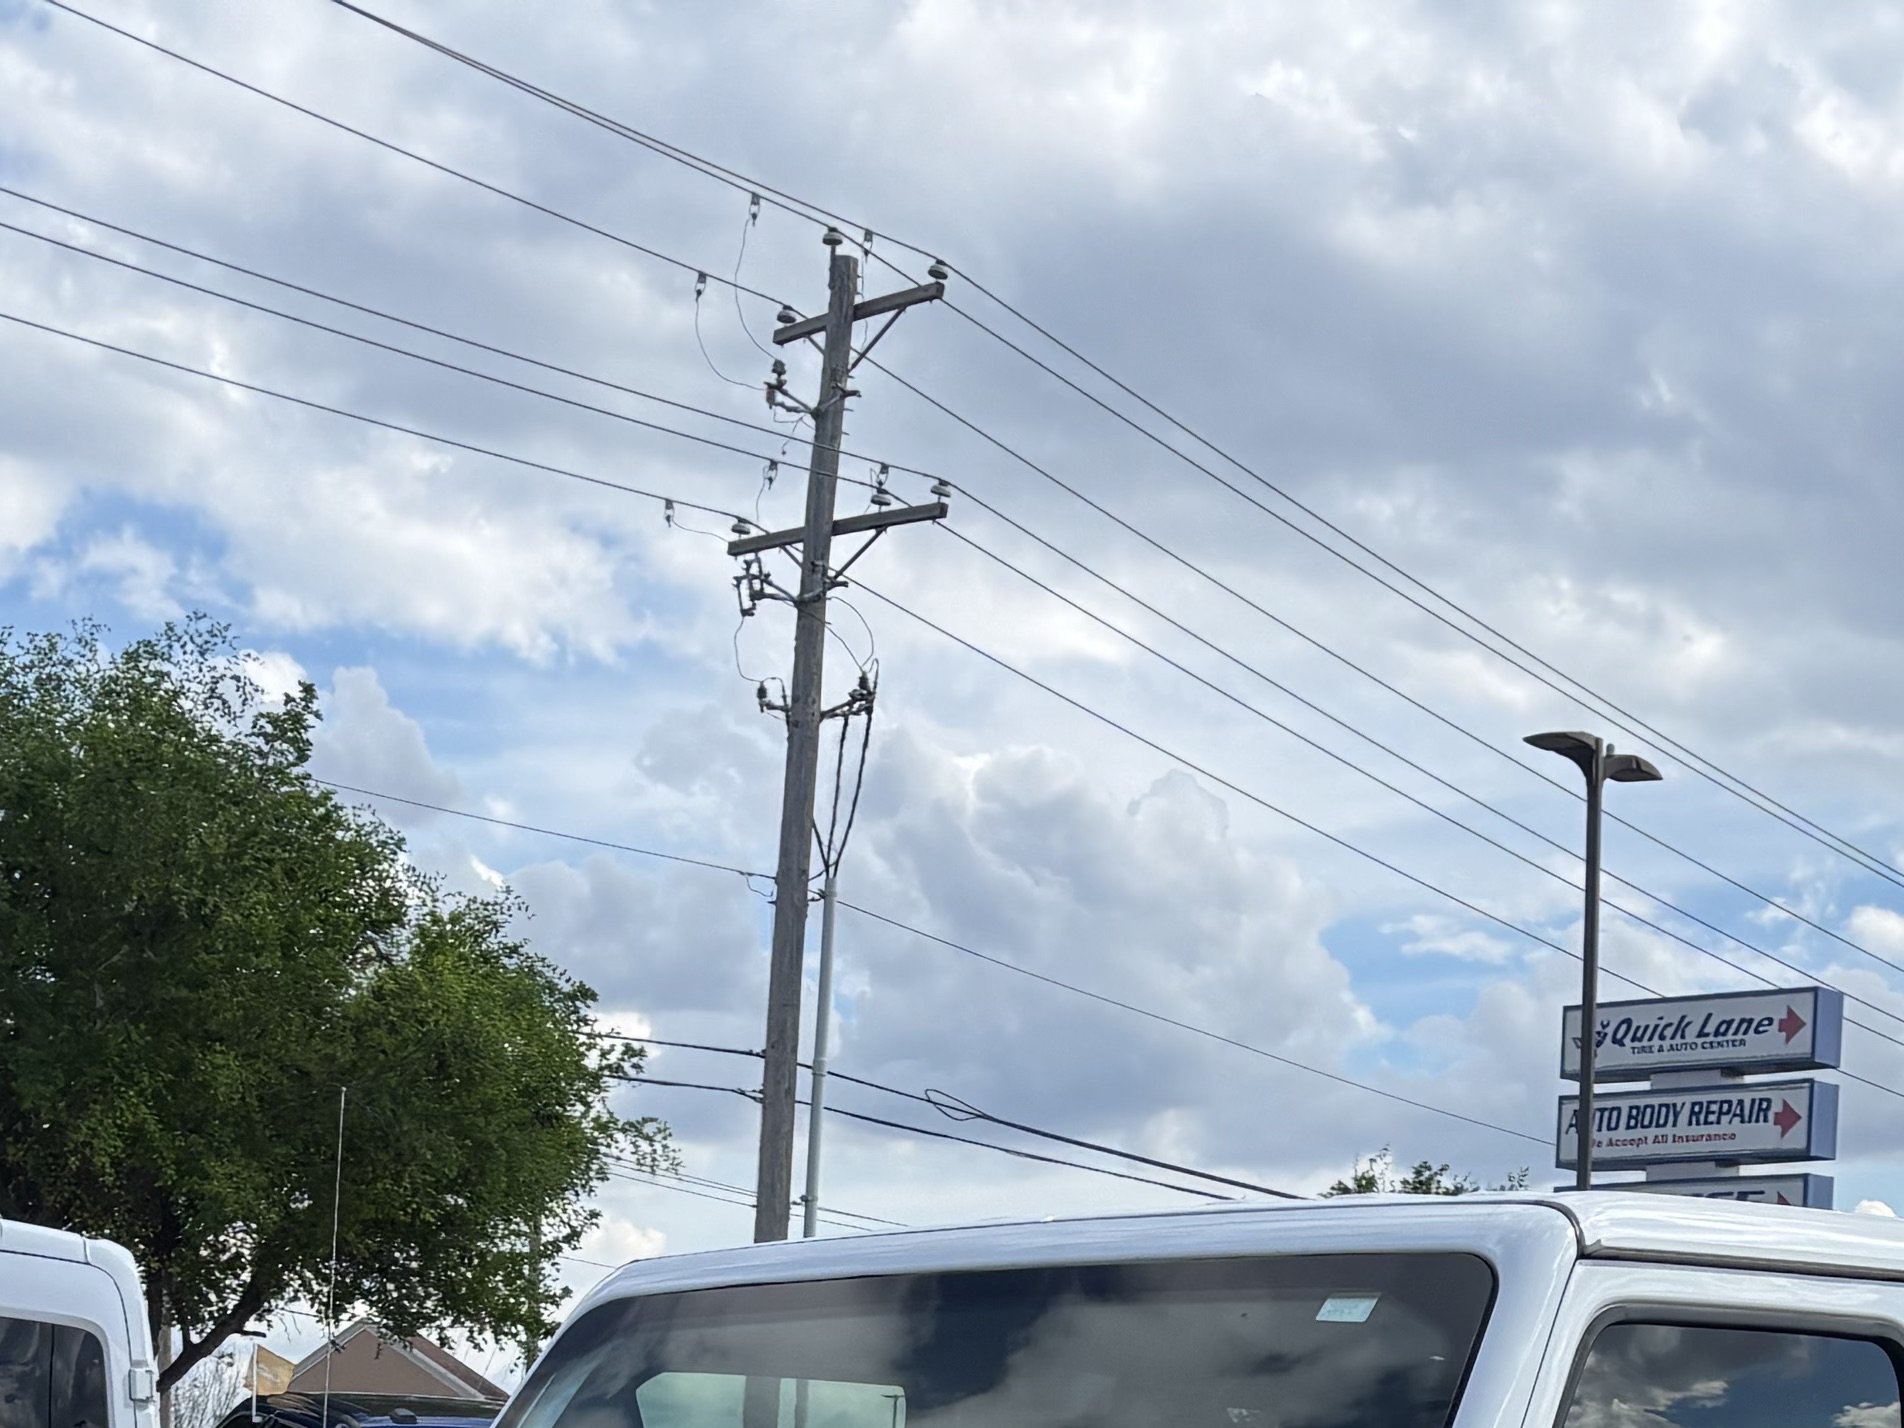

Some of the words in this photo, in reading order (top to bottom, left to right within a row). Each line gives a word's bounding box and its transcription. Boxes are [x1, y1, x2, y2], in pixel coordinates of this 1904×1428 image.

[1611, 1014, 1693, 1047] Quick
[1696, 1013, 1774, 1040] Lane
[1630, 1044, 1655, 1055] TIRE
[1667, 1041, 1698, 1053] AUTO
[1701, 1038, 1747, 1051] CENTER
[1565, 1107, 1622, 1135] ATO
[1625, 1102, 1686, 1131] BODY
[1687, 1098, 1773, 1127] REPAIR
[1606, 1133, 1649, 1149] Accept
[1652, 1133, 1669, 1145] All
[1671, 1131, 1737, 1145] Insurance
